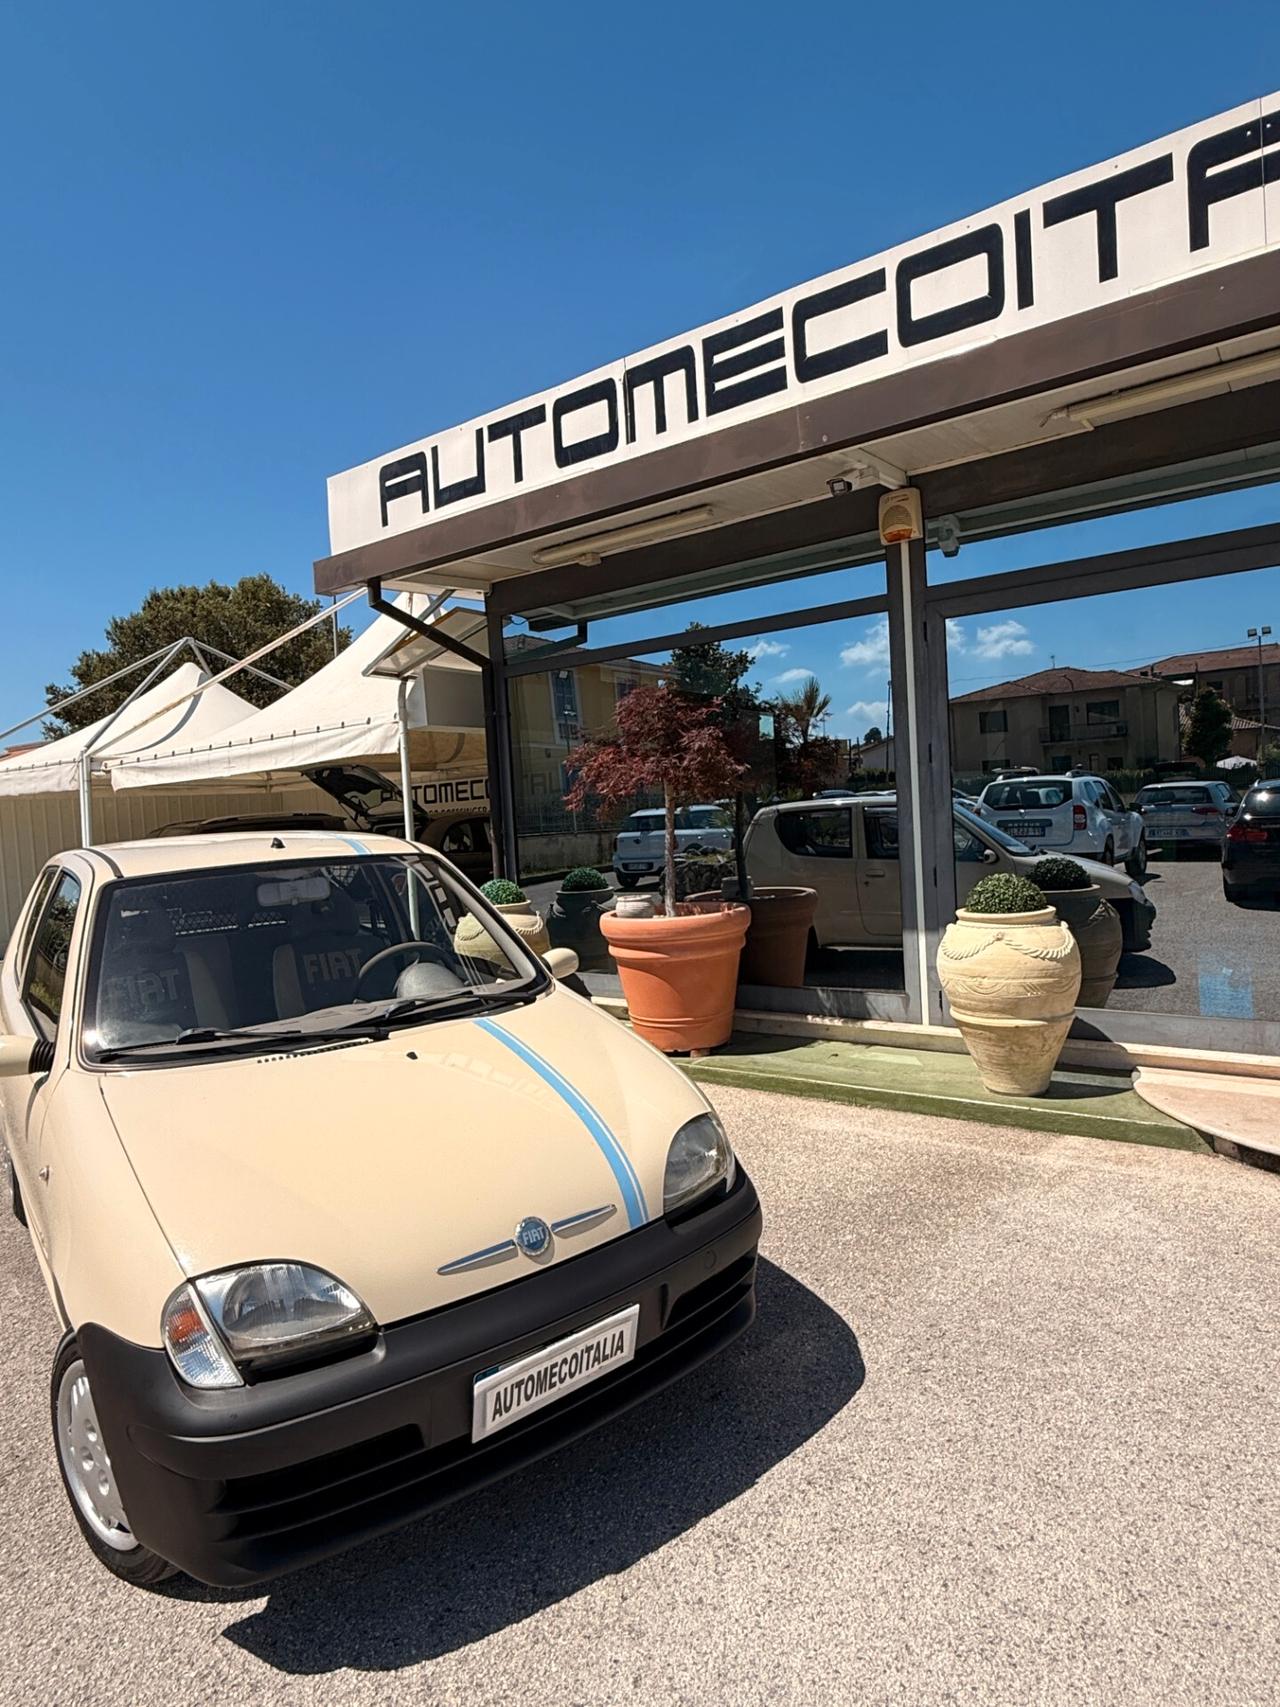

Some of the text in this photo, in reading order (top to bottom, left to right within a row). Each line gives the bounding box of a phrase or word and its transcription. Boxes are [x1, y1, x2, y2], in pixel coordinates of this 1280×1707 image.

[302, 948, 363, 984] FIAT
[522, 1227, 546, 1246] FIAT
[490, 1329, 625, 1422] AUTOMECOITALIA
